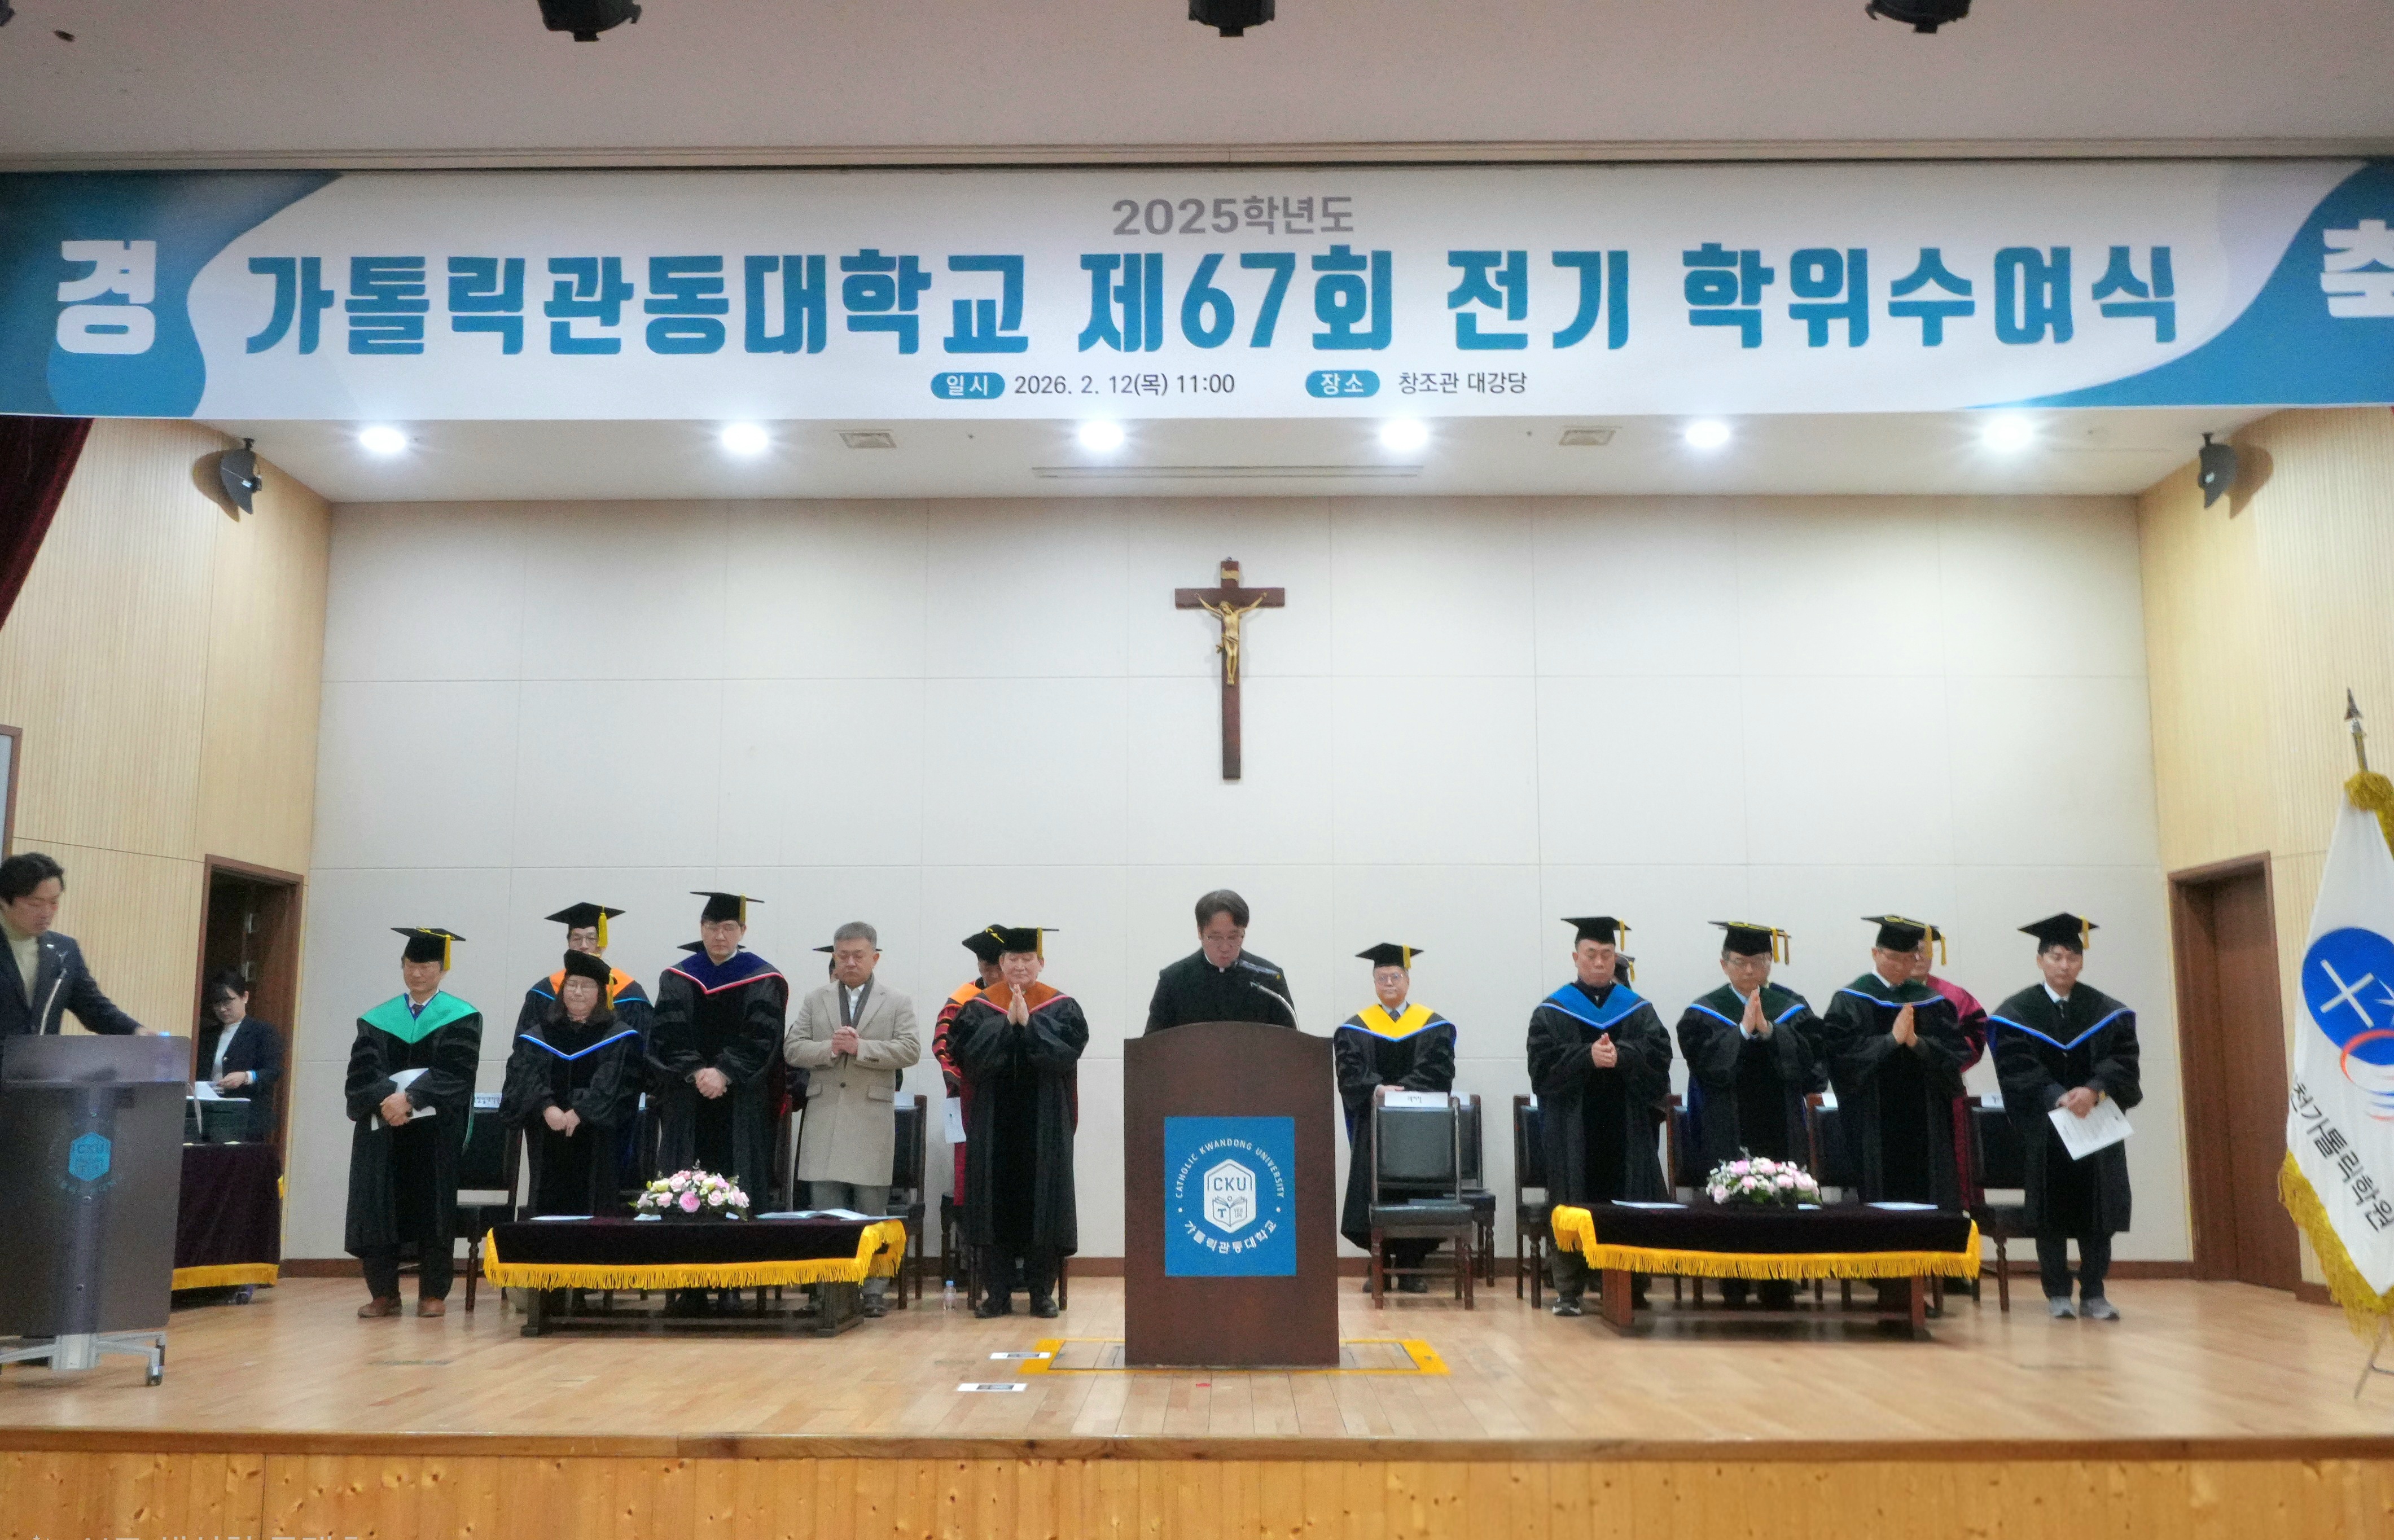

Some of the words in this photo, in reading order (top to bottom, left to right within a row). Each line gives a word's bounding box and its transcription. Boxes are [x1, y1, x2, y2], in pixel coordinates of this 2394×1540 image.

[1112, 195, 1353, 236] 2025학년도
[2320, 218, 2394, 318] 축
[56, 239, 157, 354] 경
[245, 248, 1029, 356] 가톨릭관동대학교
[1078, 244, 1392, 352] 제67회
[1448, 250, 1629, 350] 전기
[1683, 243, 2176, 348] 학위수여식
[1015, 375, 1072, 394] 2026.
[1081, 375, 1099, 394] 2.
[1109, 373, 1168, 396] 12(목)
[1177, 374, 1235, 393] 11:00
[1398, 372, 1459, 394] 창조관
[1467, 372, 1527, 394] 대강당
[1175, 1153, 1198, 1199] CATHOLIC
[1199, 1138, 1252, 1155] KWANDONG
[1255, 1147, 1284, 1198] UNIVERSITY
[1213, 1177, 1247, 1191] CKU
